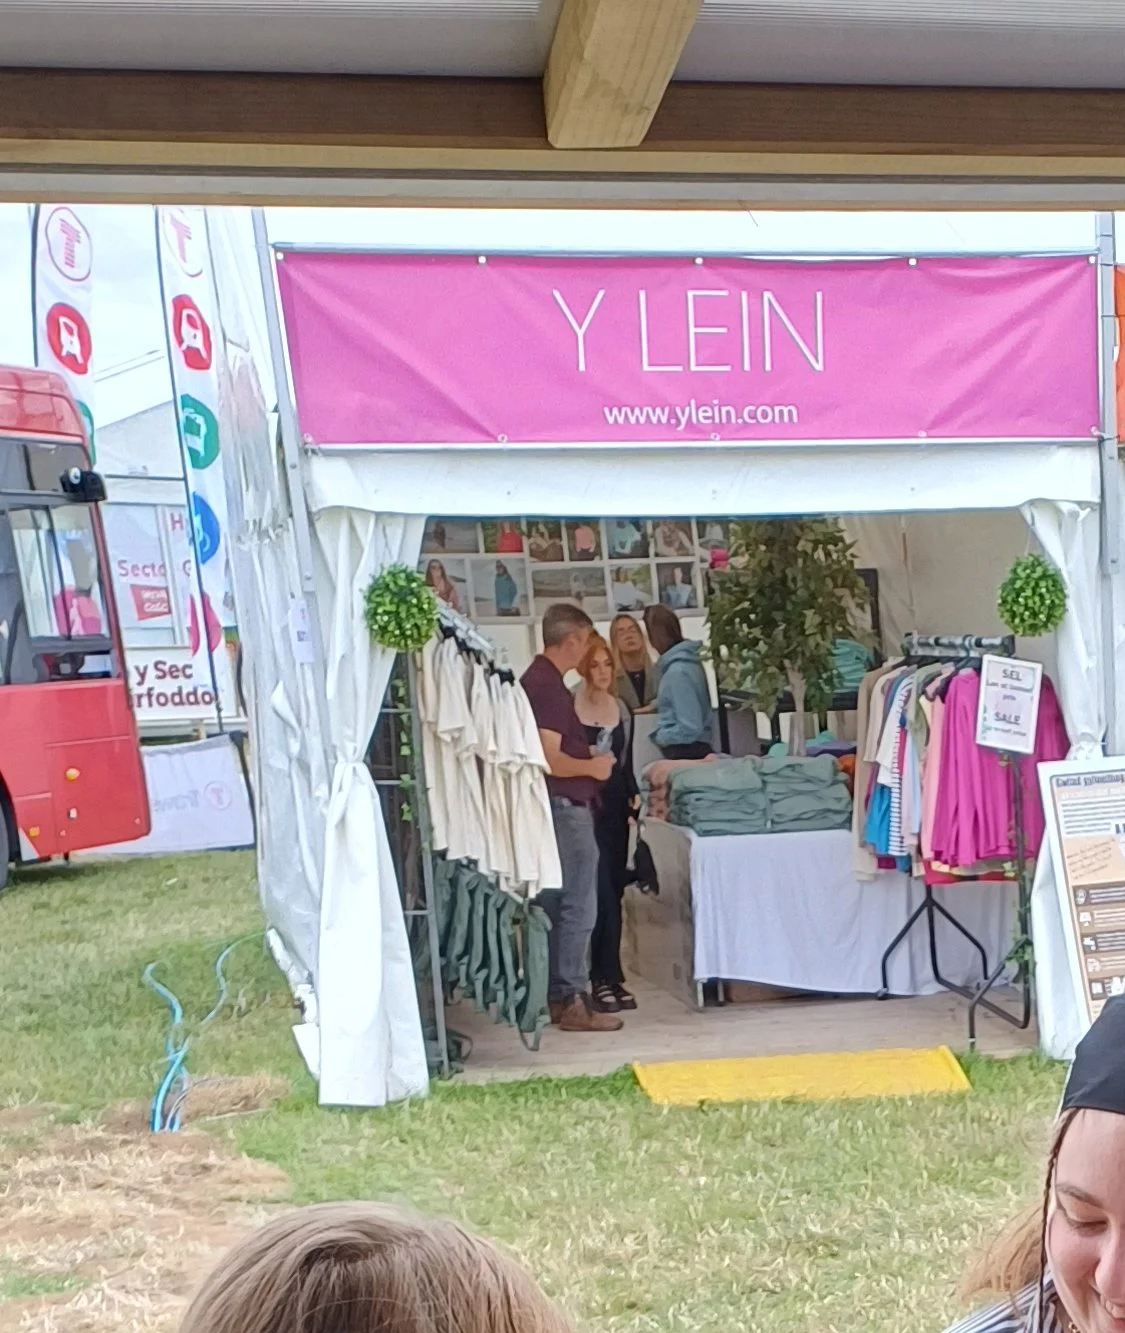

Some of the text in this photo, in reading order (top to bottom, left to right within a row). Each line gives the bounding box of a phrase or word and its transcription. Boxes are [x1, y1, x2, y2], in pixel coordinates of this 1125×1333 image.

[552, 288, 825, 372] Y LEIN
[603, 398, 799, 431] www.ylein.com
